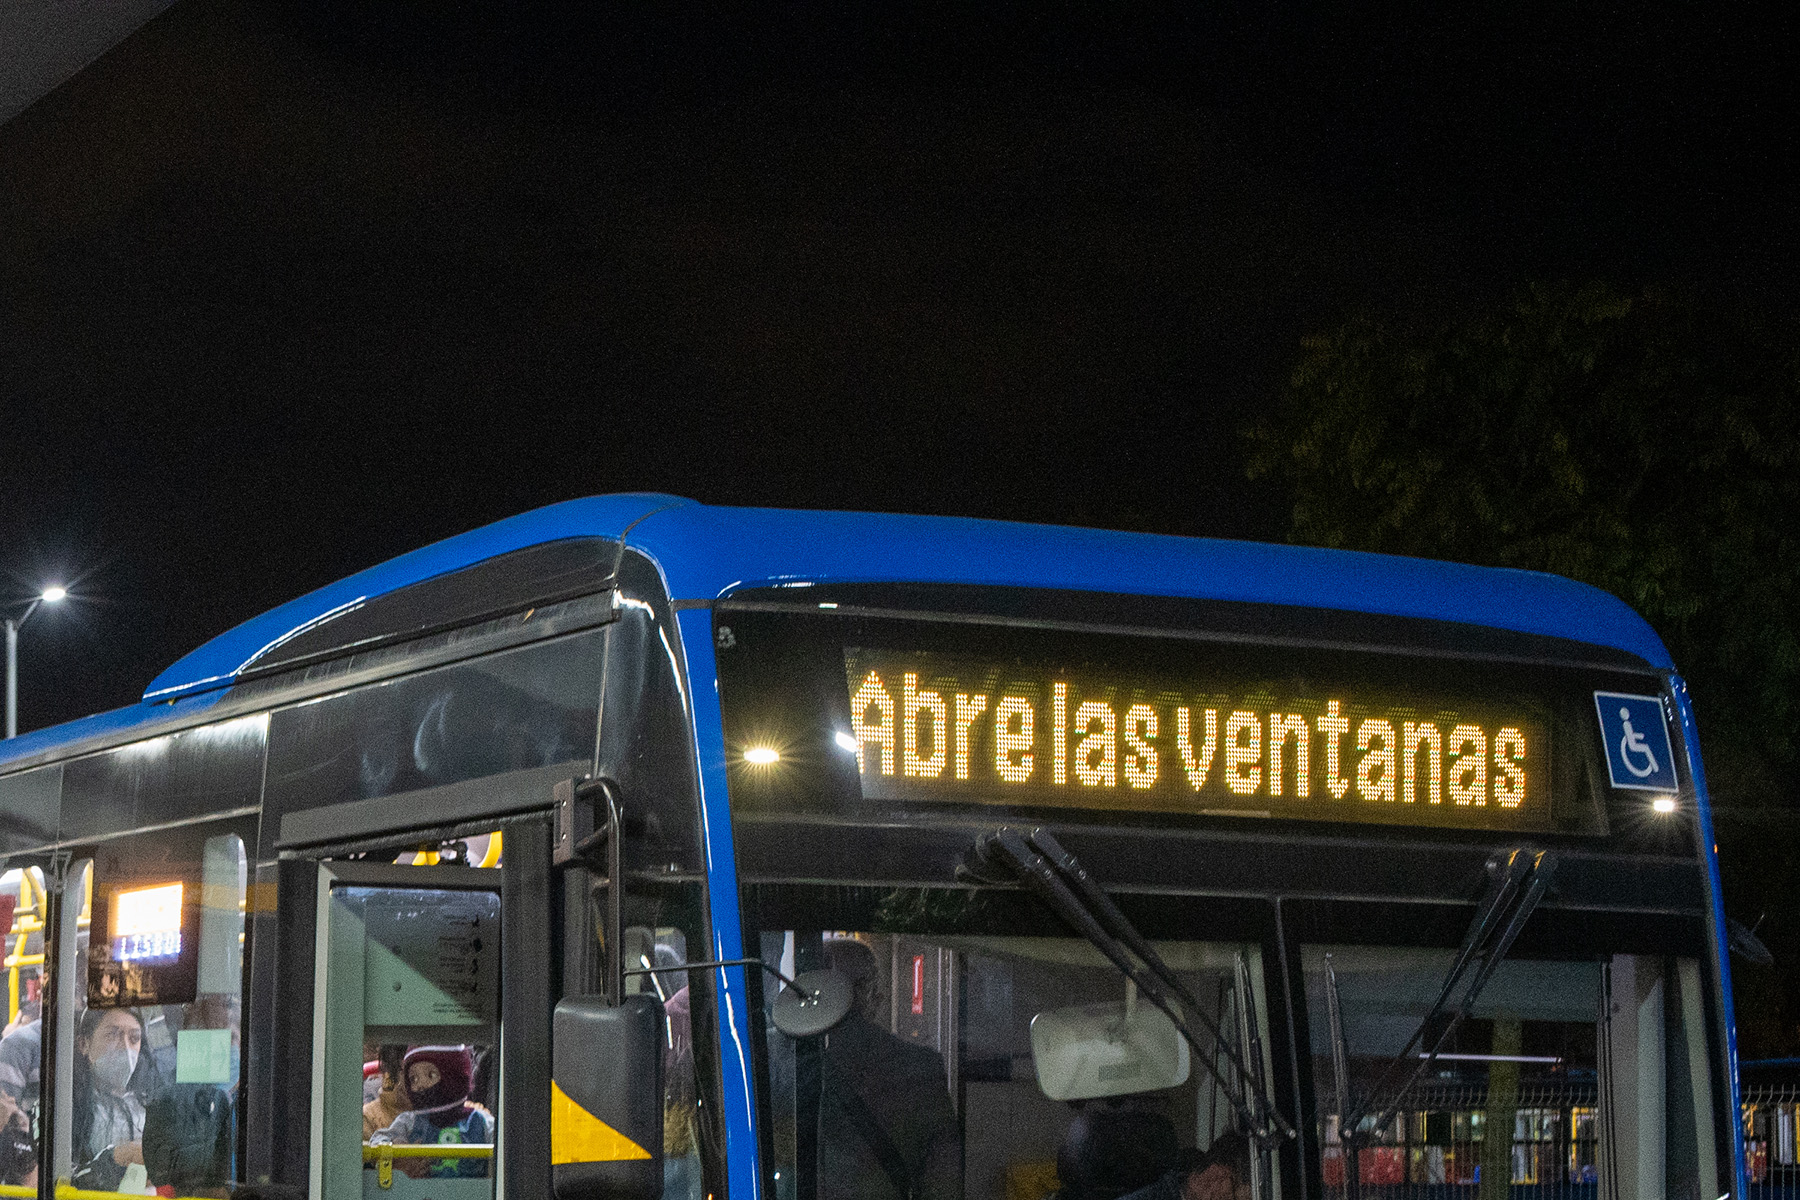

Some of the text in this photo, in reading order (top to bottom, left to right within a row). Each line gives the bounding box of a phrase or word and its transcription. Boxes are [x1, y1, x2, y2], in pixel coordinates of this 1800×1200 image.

[851, 669, 1528, 809] Abre las ventanas
